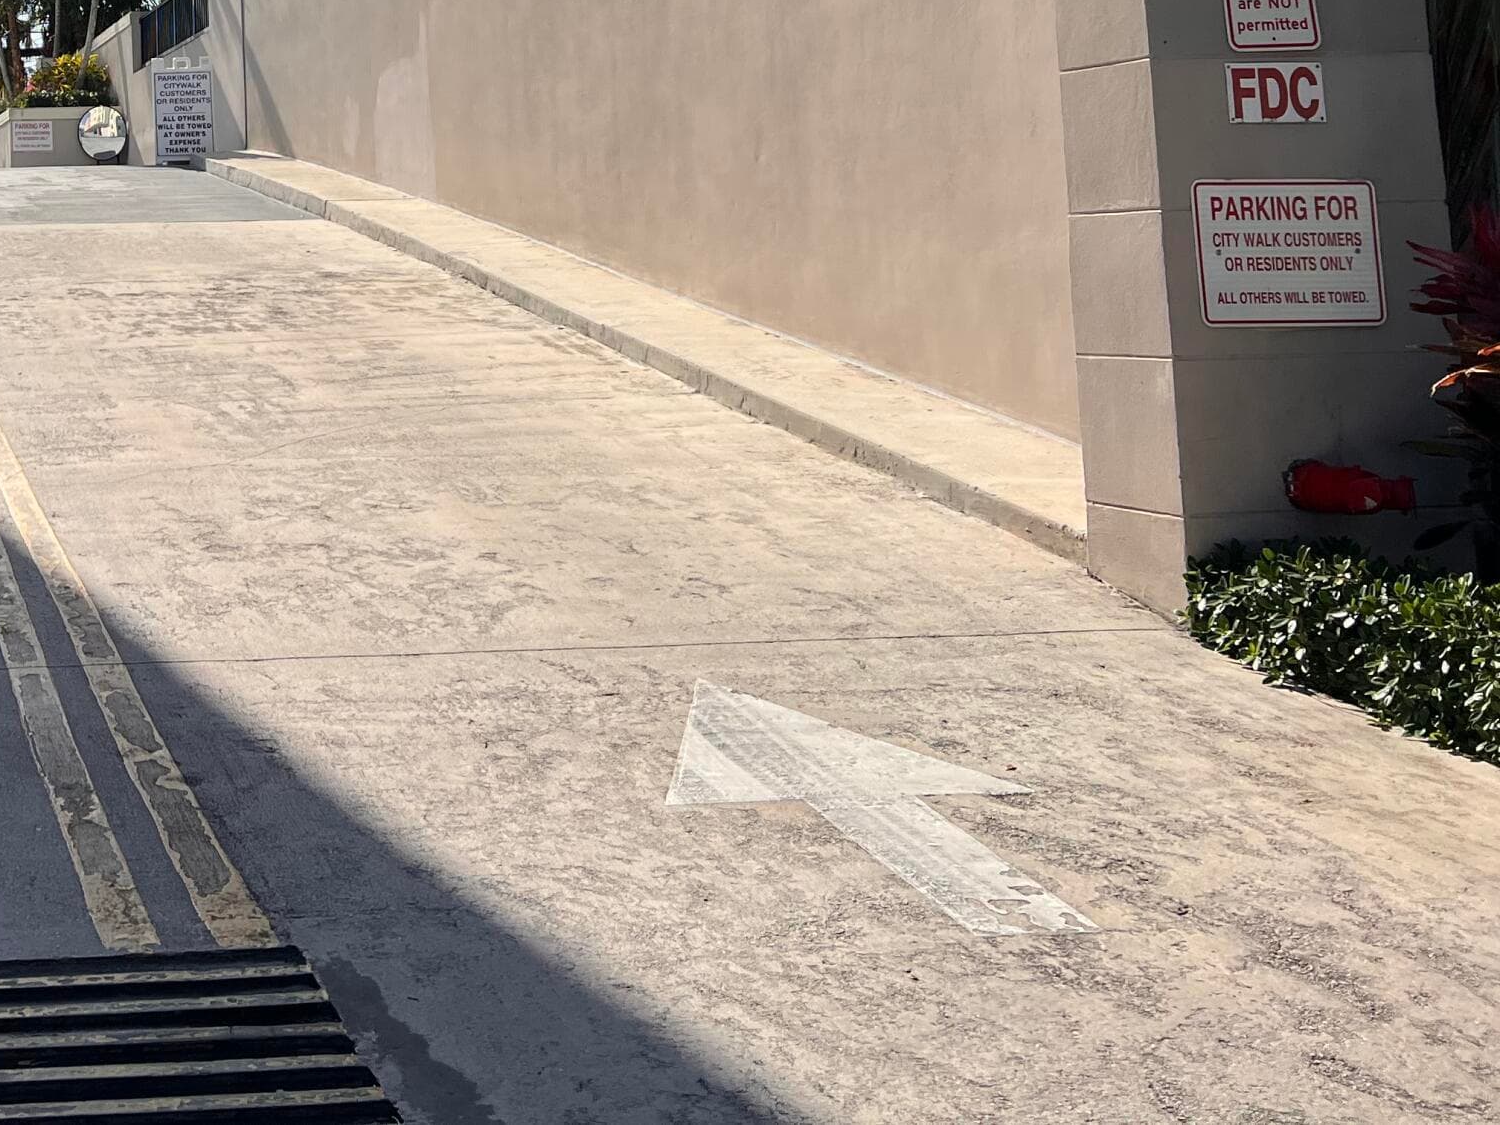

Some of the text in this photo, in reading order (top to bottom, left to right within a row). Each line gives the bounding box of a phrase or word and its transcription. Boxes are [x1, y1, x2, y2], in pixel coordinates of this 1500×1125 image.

[1237, 17, 1309, 34] permitted
[1231, 66, 1320, 121] FDC
[1210, 195, 1358, 221] PARKING FOR
[1212, 232, 1362, 248] CITY WALK CUSTOMERS
[1224, 256, 1354, 271] OR RESIDENTS ONLY
[1217, 292, 1237, 304] ALL
[1239, 292, 1282, 304] OTHERS
[1284, 292, 1309, 304] WILL
[1312, 292, 1326, 304] BE
